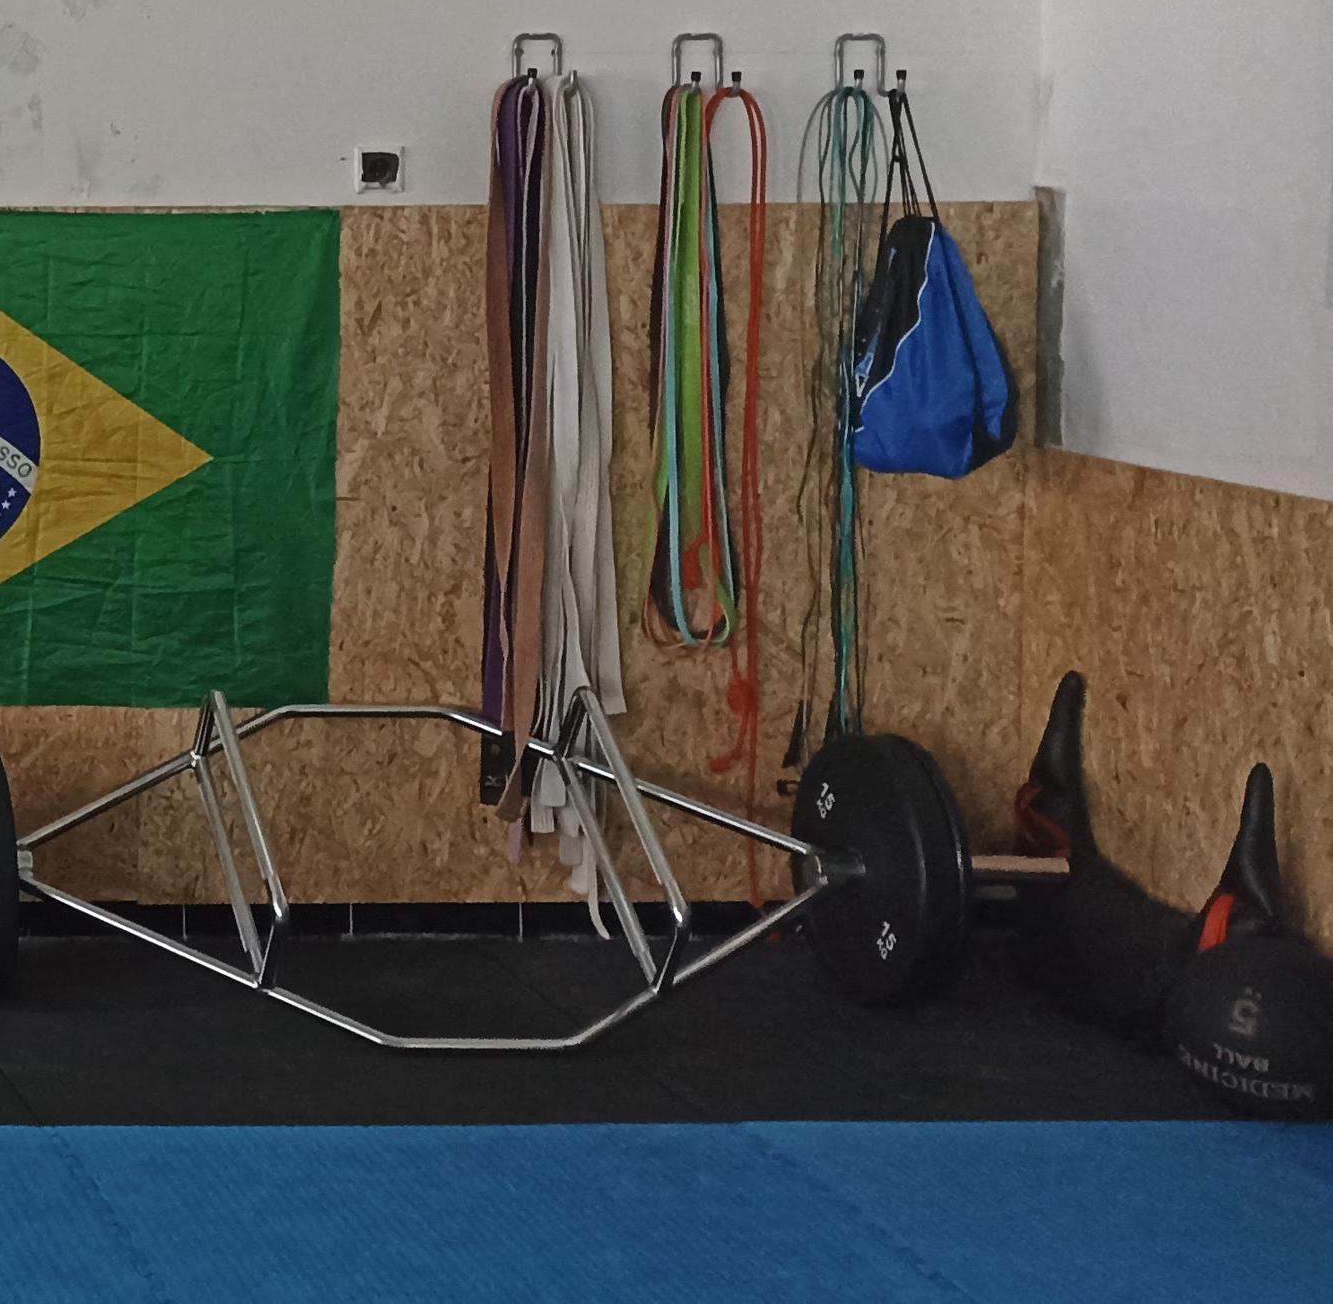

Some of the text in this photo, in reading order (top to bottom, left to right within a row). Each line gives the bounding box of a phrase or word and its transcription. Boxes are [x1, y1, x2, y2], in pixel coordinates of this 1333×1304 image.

[821, 782, 836, 811] 15
[881, 921, 897, 952] 15
[1229, 999, 1259, 1037] 5
[1177, 1042, 1315, 1100] MEDICINE
[1212, 1040, 1270, 1073] BALL
